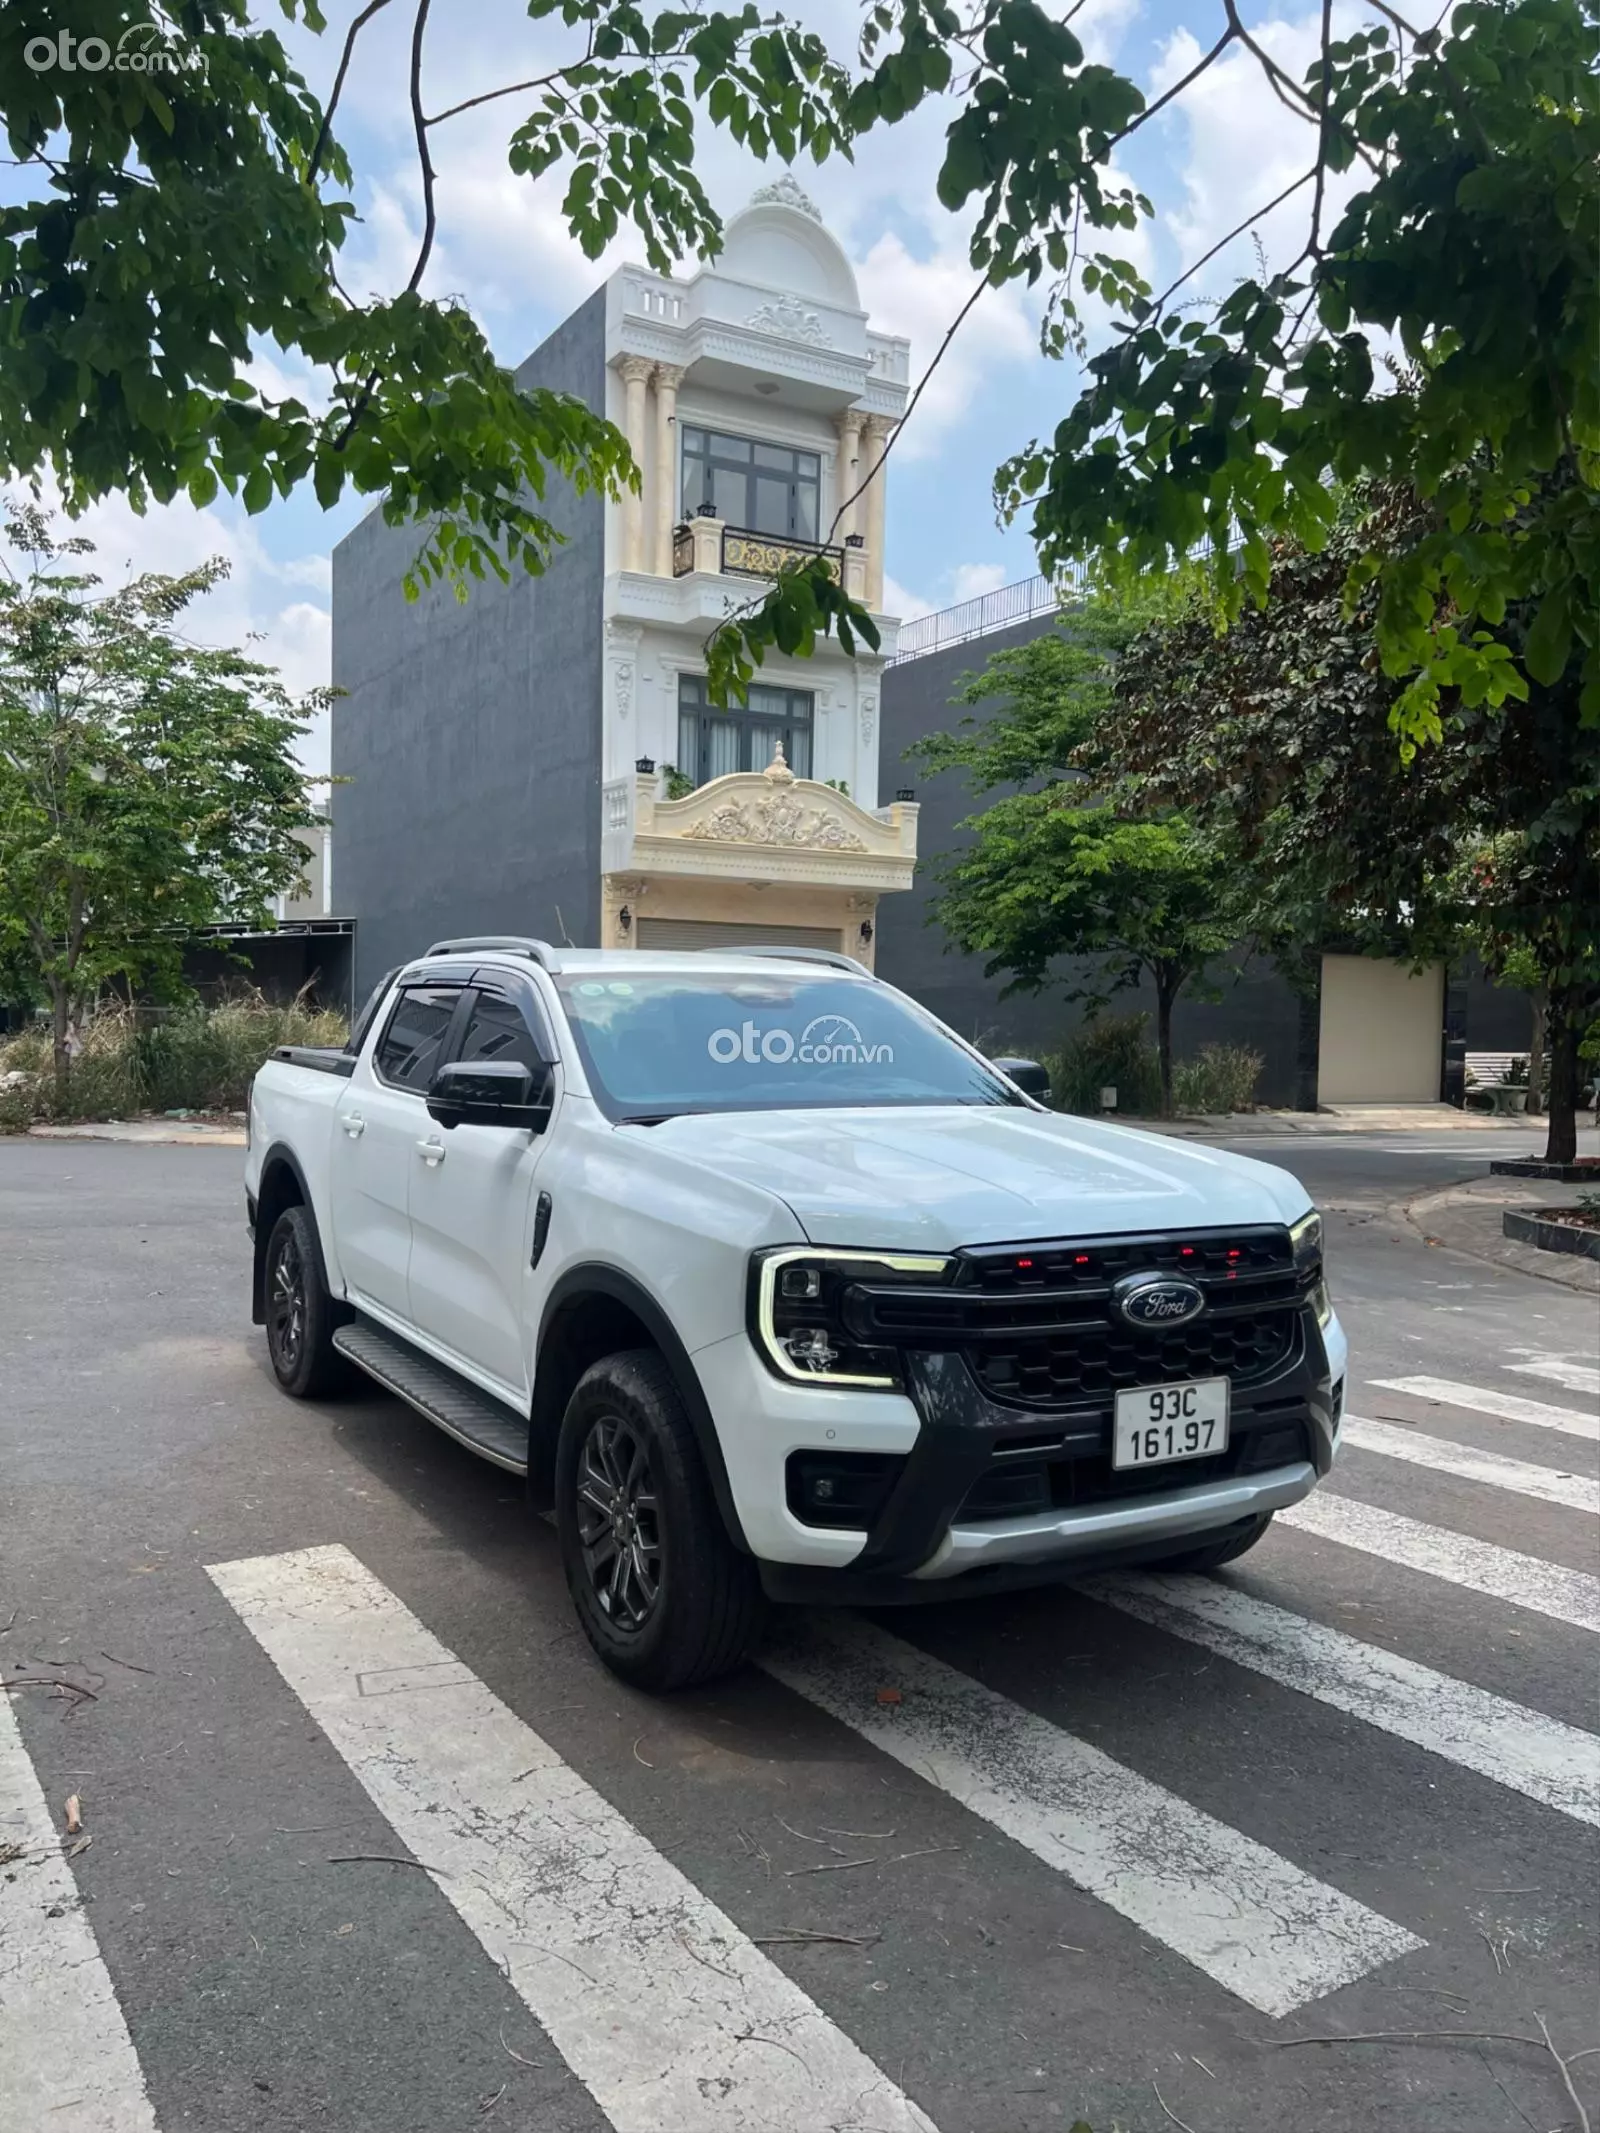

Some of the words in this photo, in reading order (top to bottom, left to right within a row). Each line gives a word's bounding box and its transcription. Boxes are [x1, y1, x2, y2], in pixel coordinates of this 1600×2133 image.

[1144, 1292, 1187, 1317] Ford
[1149, 1387, 1198, 1422] 93C
[1131, 1419, 1215, 1460] 161.97
